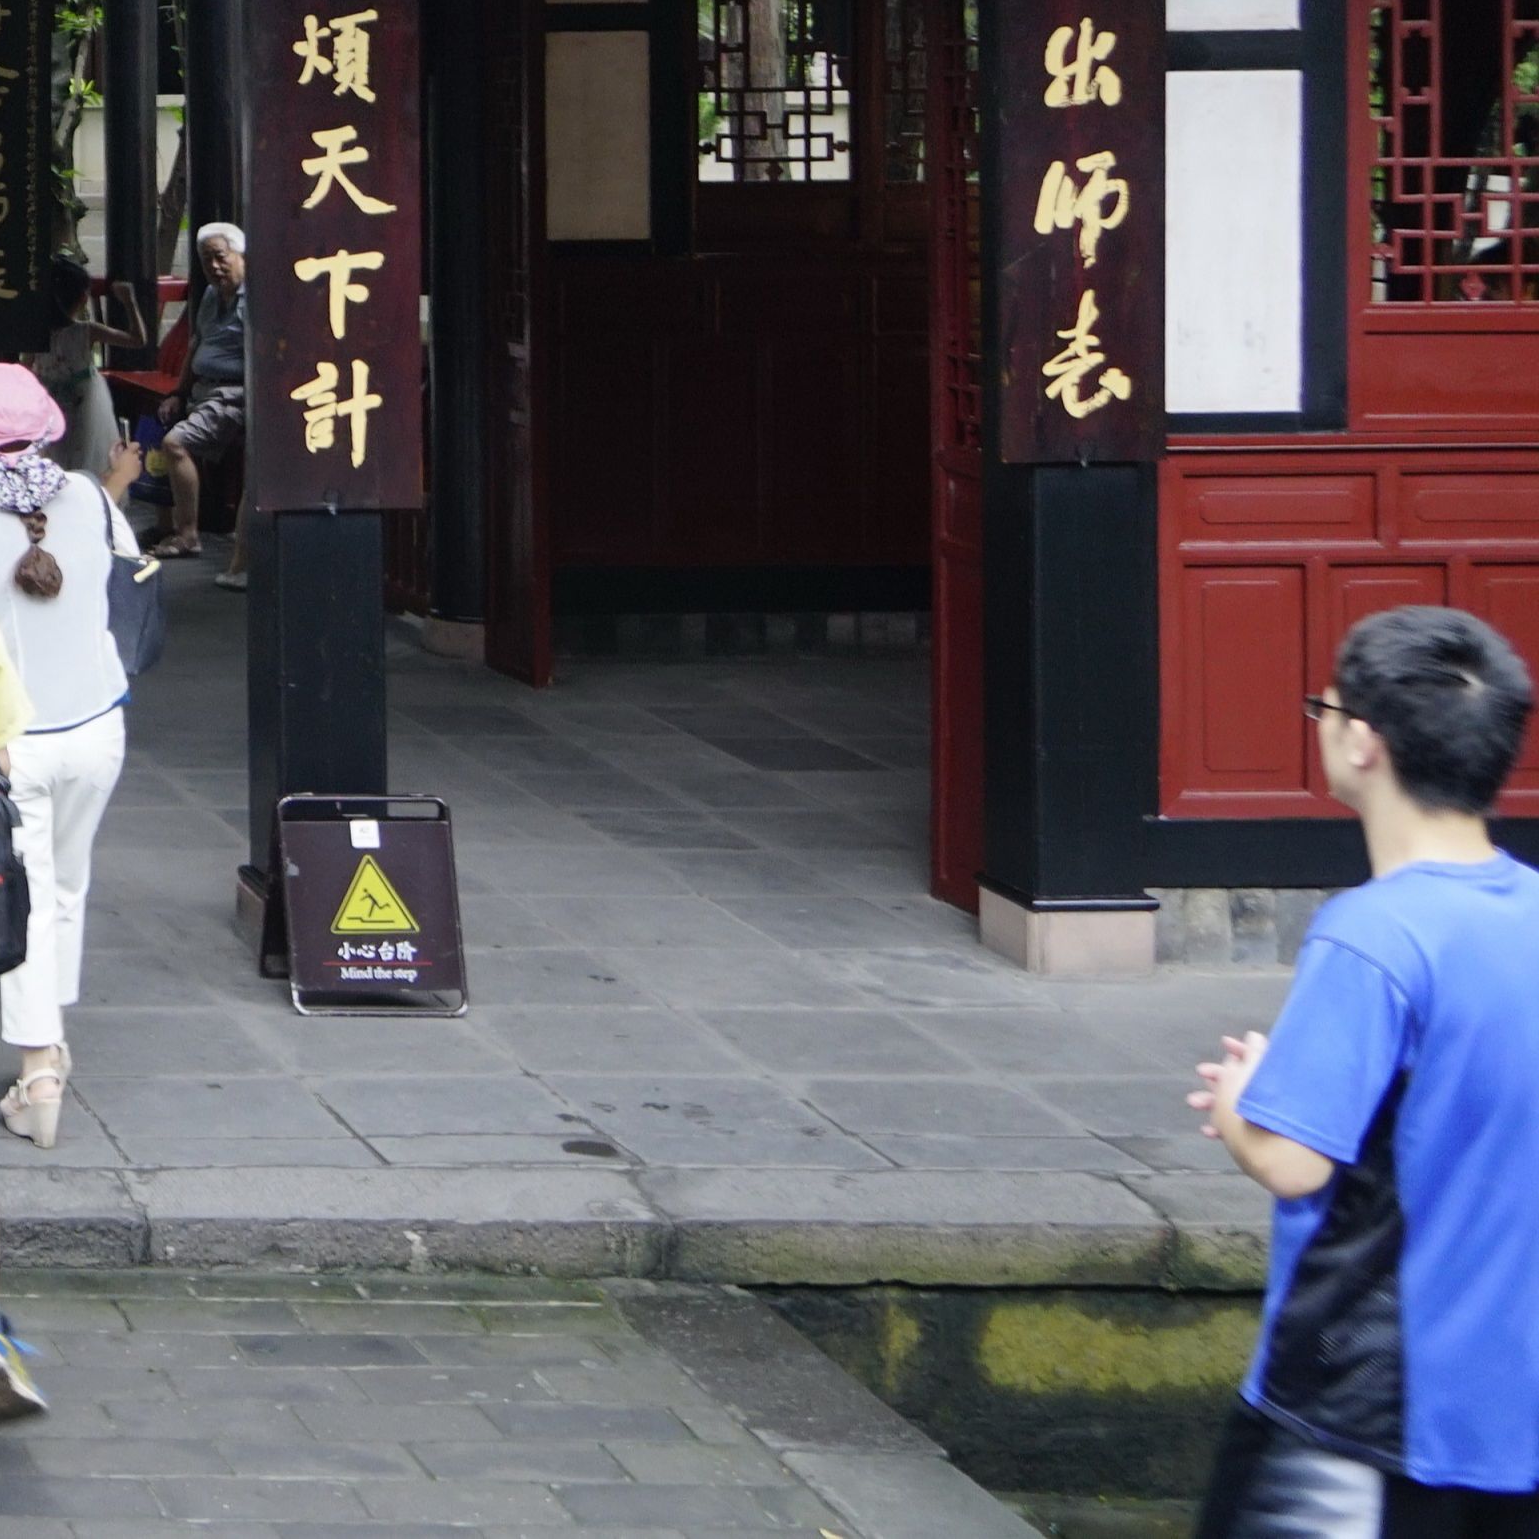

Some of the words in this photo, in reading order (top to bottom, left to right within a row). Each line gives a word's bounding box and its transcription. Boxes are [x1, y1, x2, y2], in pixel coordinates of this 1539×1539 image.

[337, 940, 418, 962] 小心台阶
[340, 966, 372, 980] Mind
[374, 966, 392, 980] the
[393, 967, 418, 983] step
